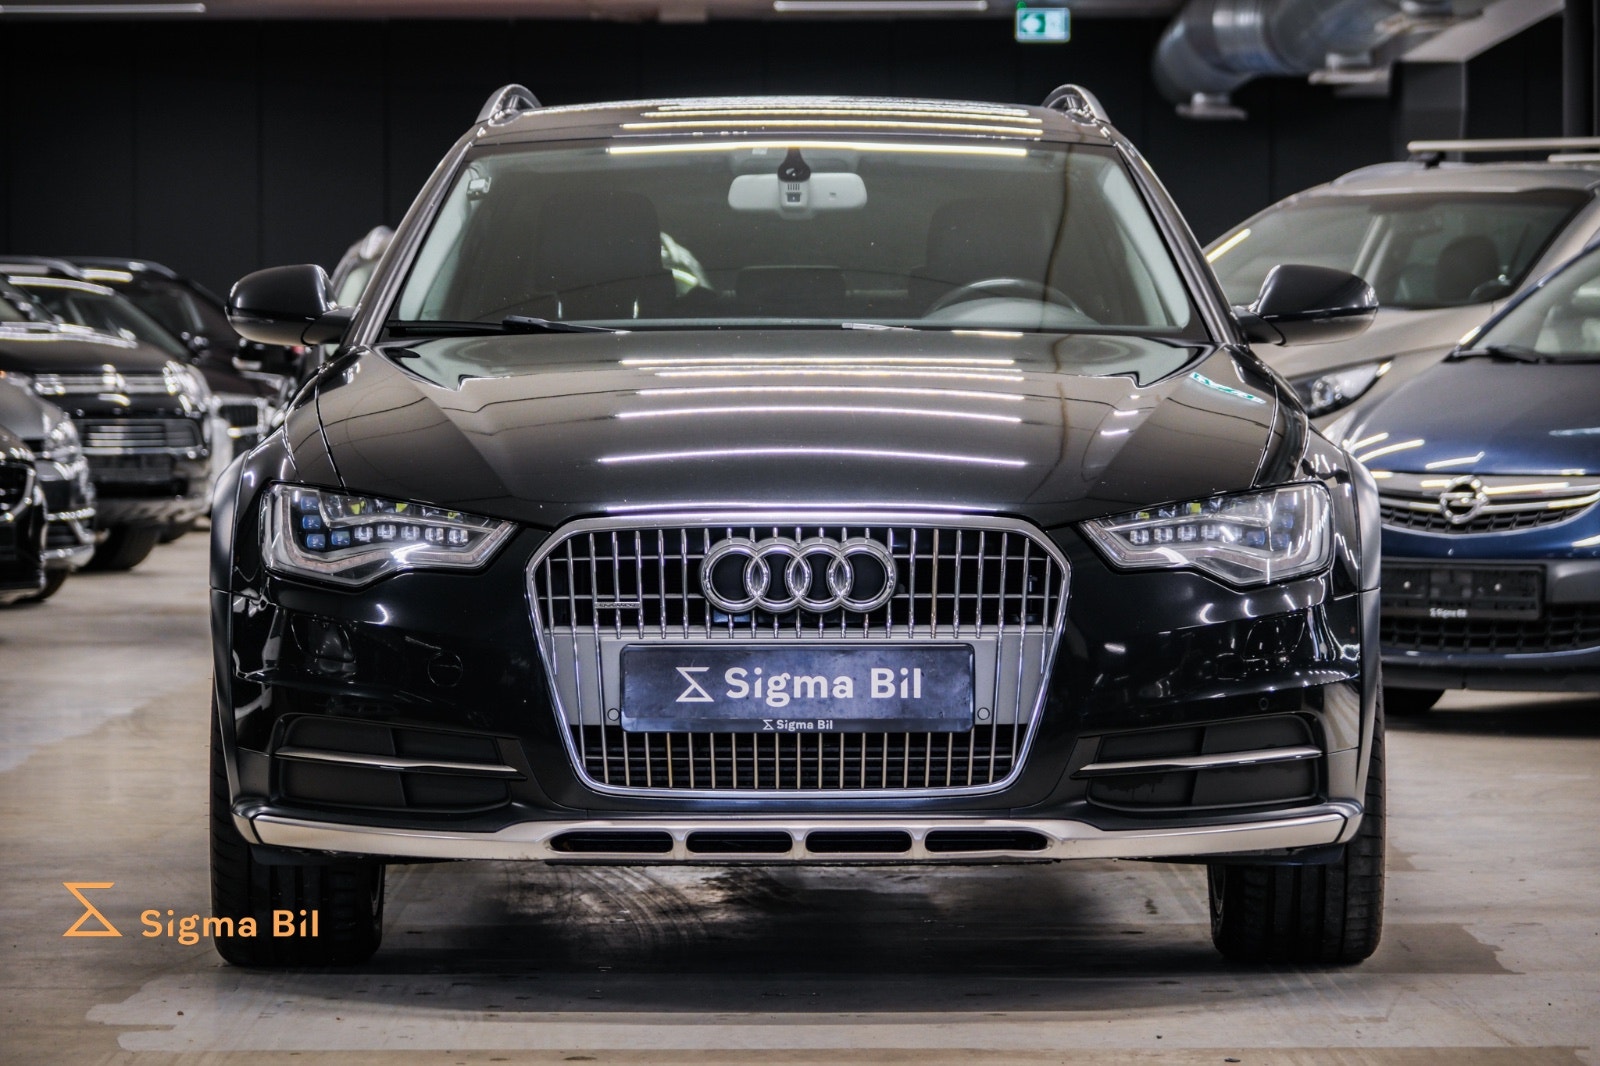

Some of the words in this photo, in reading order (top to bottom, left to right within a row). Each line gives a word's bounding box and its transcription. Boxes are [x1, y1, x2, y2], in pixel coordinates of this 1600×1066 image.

[725, 667, 854, 708] Sigma
[870, 667, 922, 699] Bil
[776, 719, 814, 732] Sigma
[817, 719, 833, 730] Bil
